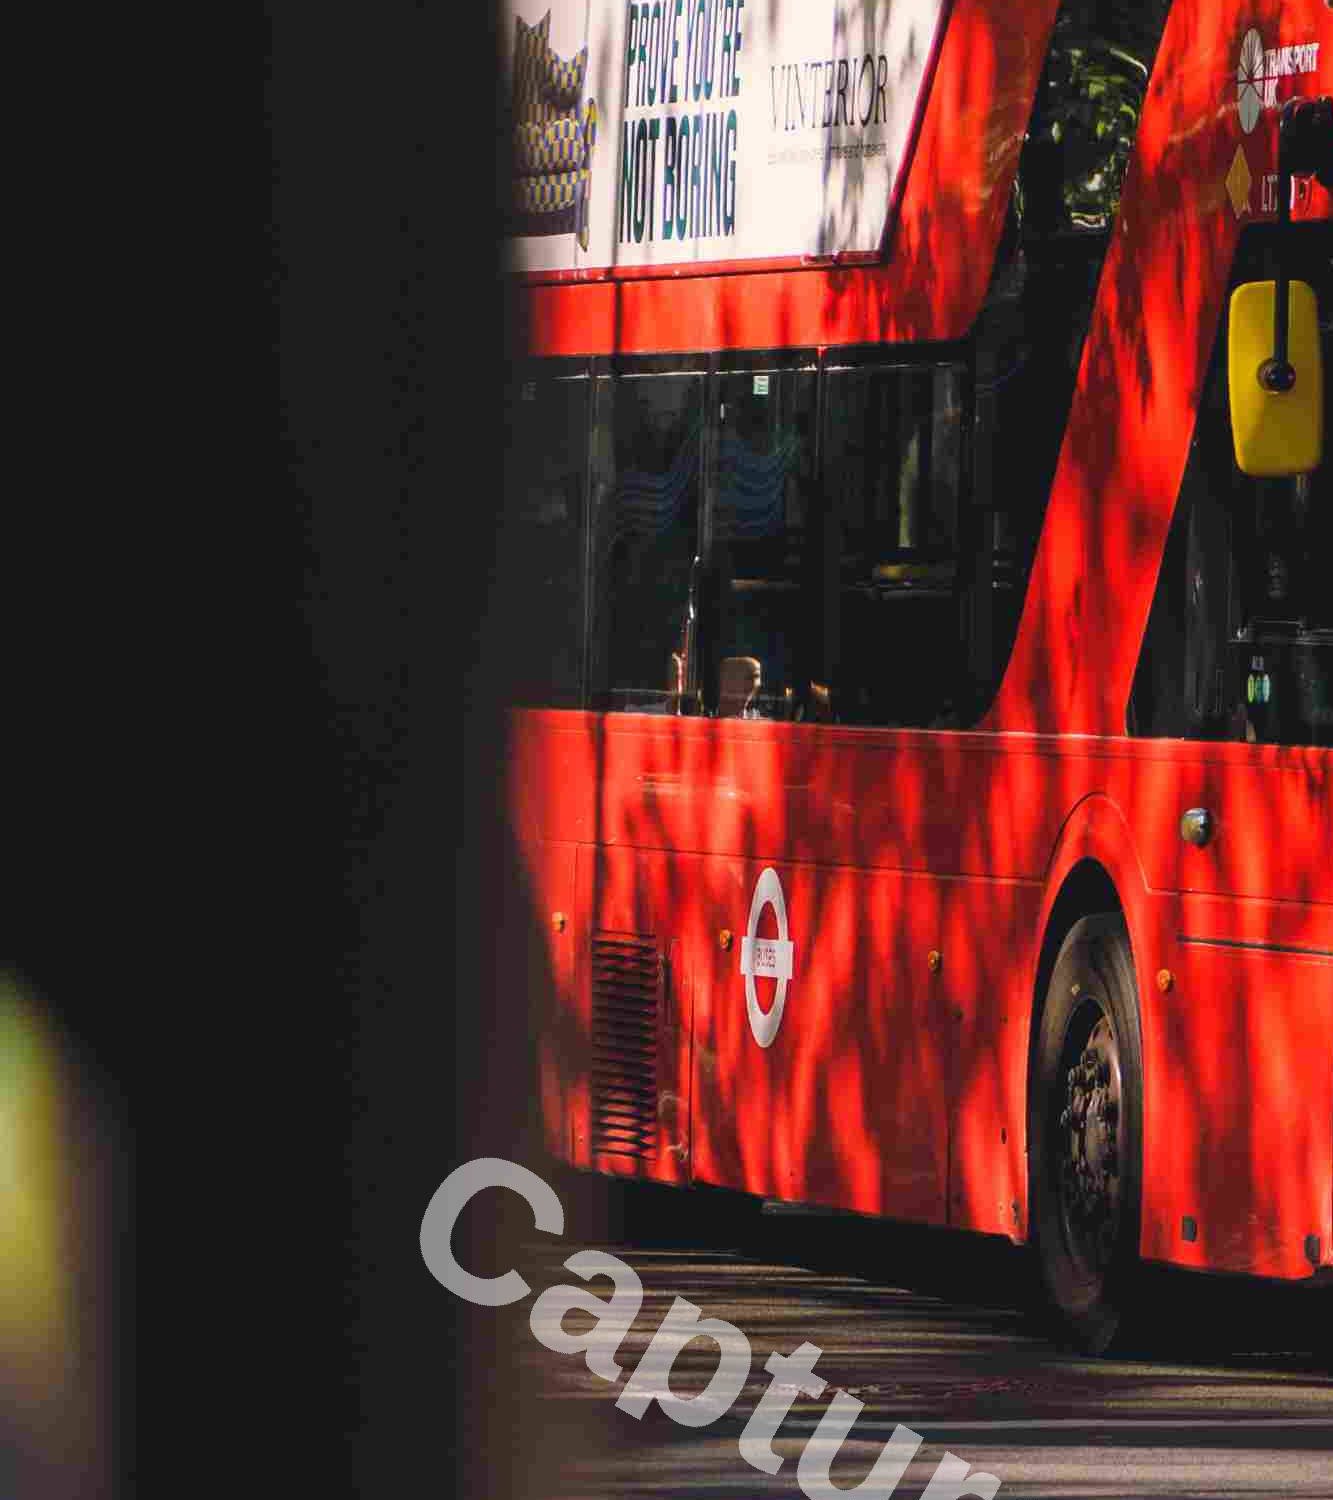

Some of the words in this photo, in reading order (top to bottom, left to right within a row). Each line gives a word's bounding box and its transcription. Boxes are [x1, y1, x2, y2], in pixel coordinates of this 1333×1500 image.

[770, 53, 888, 132] VINTERIOR
[619, 117, 660, 244] NOT
[662, 109, 737, 240] BORING
